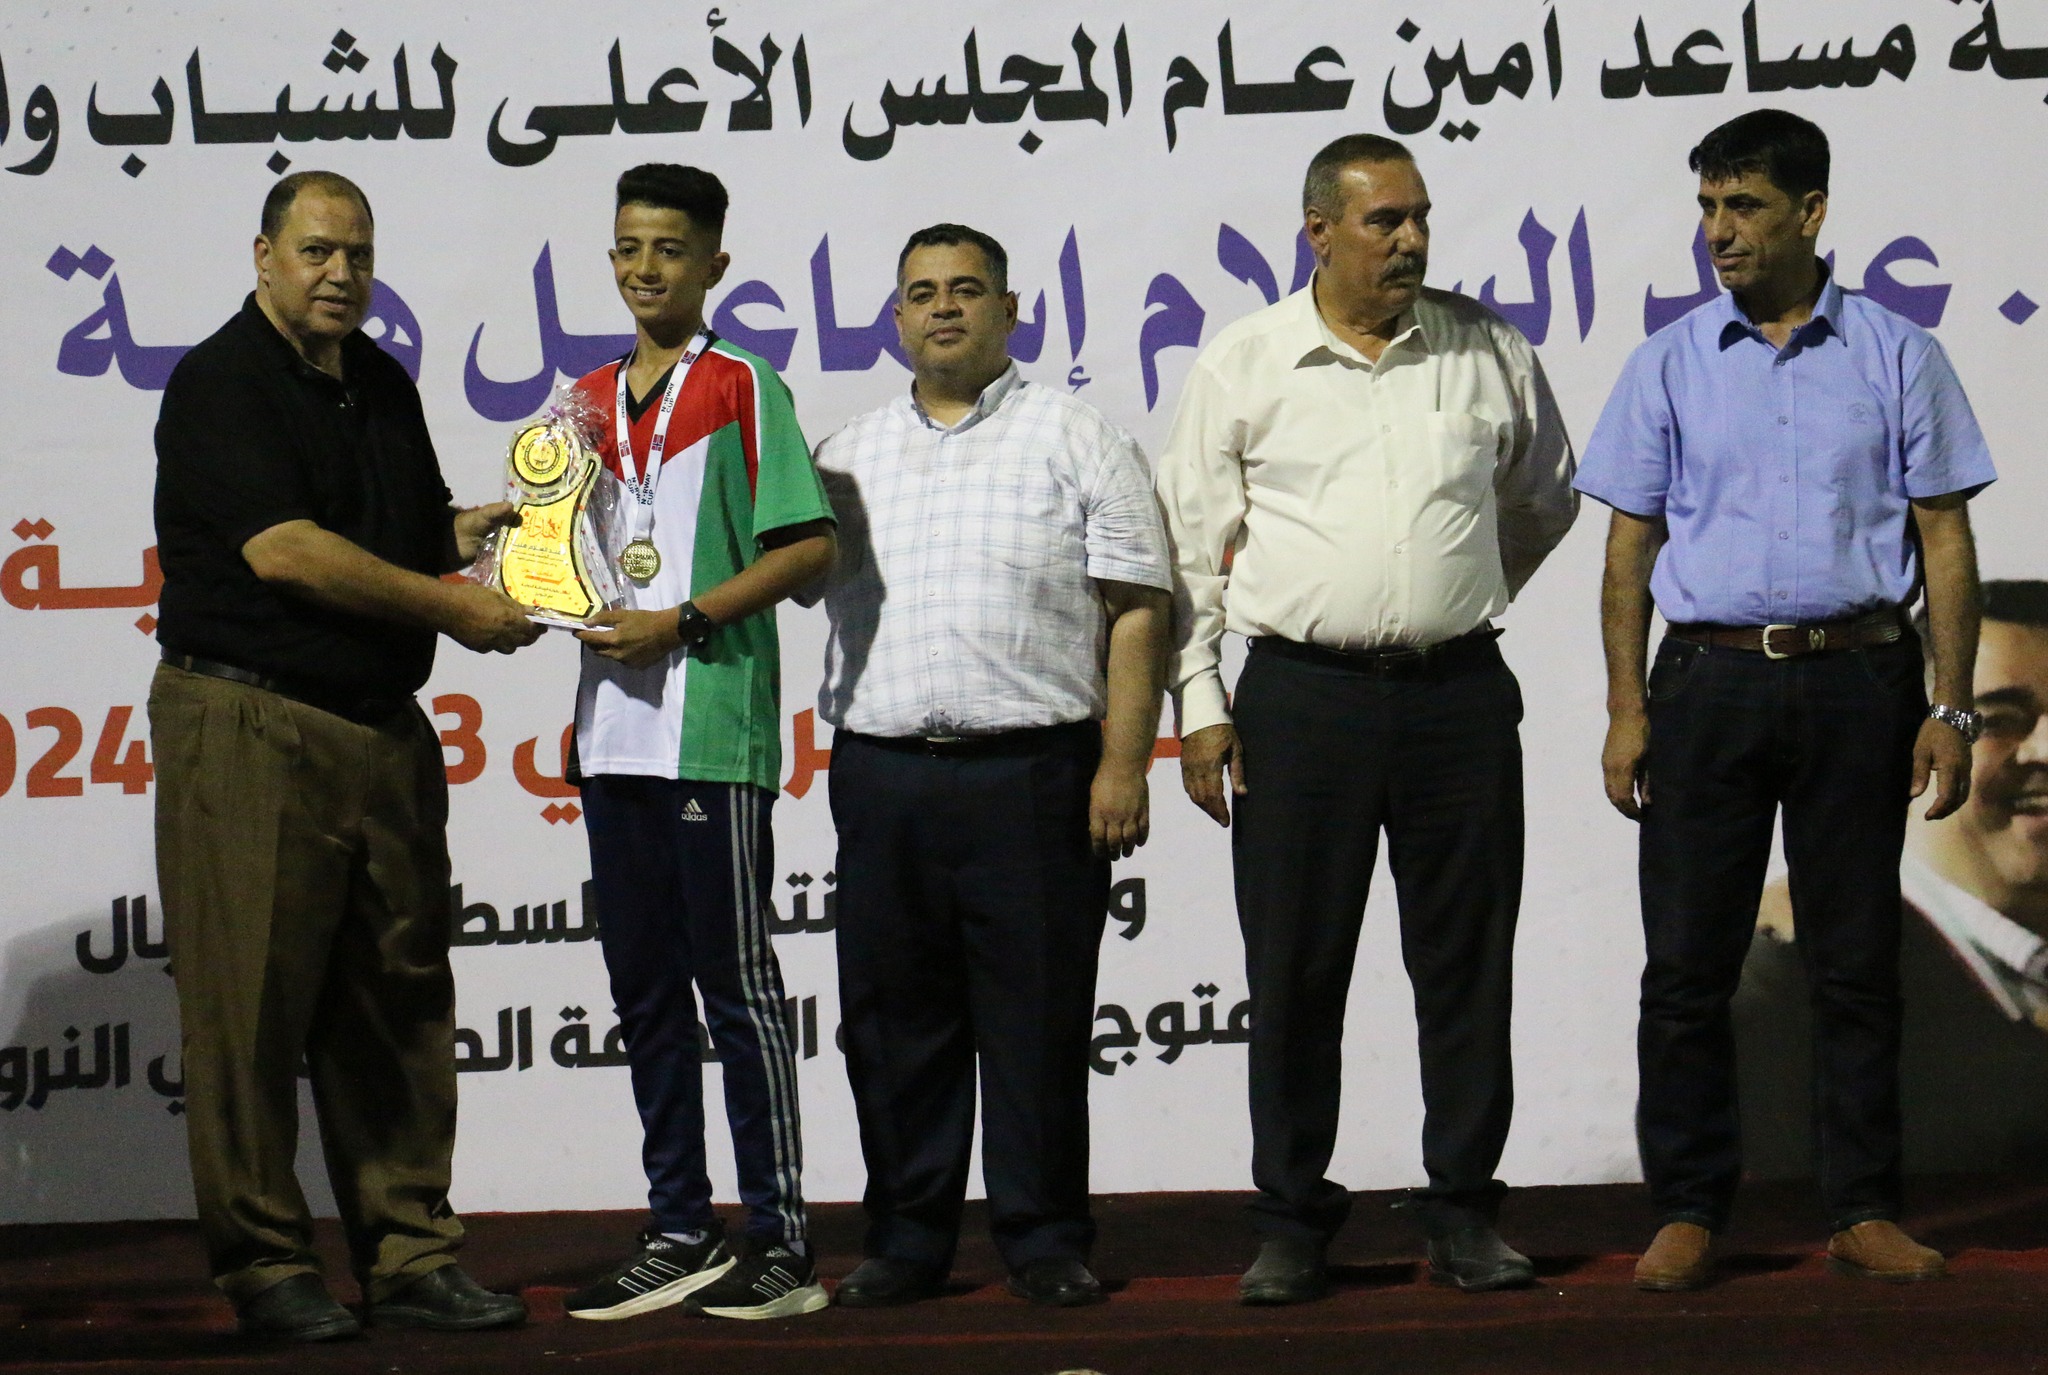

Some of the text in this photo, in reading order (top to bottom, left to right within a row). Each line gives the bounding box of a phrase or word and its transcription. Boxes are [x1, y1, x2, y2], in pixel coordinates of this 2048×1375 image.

[86, 28, 458, 178] للشباب
[486, 7, 812, 167] الأعلى
[842, 22, 1133, 162] المجلس
[1163, 18, 1356, 154] عام
[1601, 0, 1917, 100] مساعد
[661, 382, 674, 412] NRWAY
[641, 473, 652, 505] NRWAY
[681, 811, 708, 821] adidas
